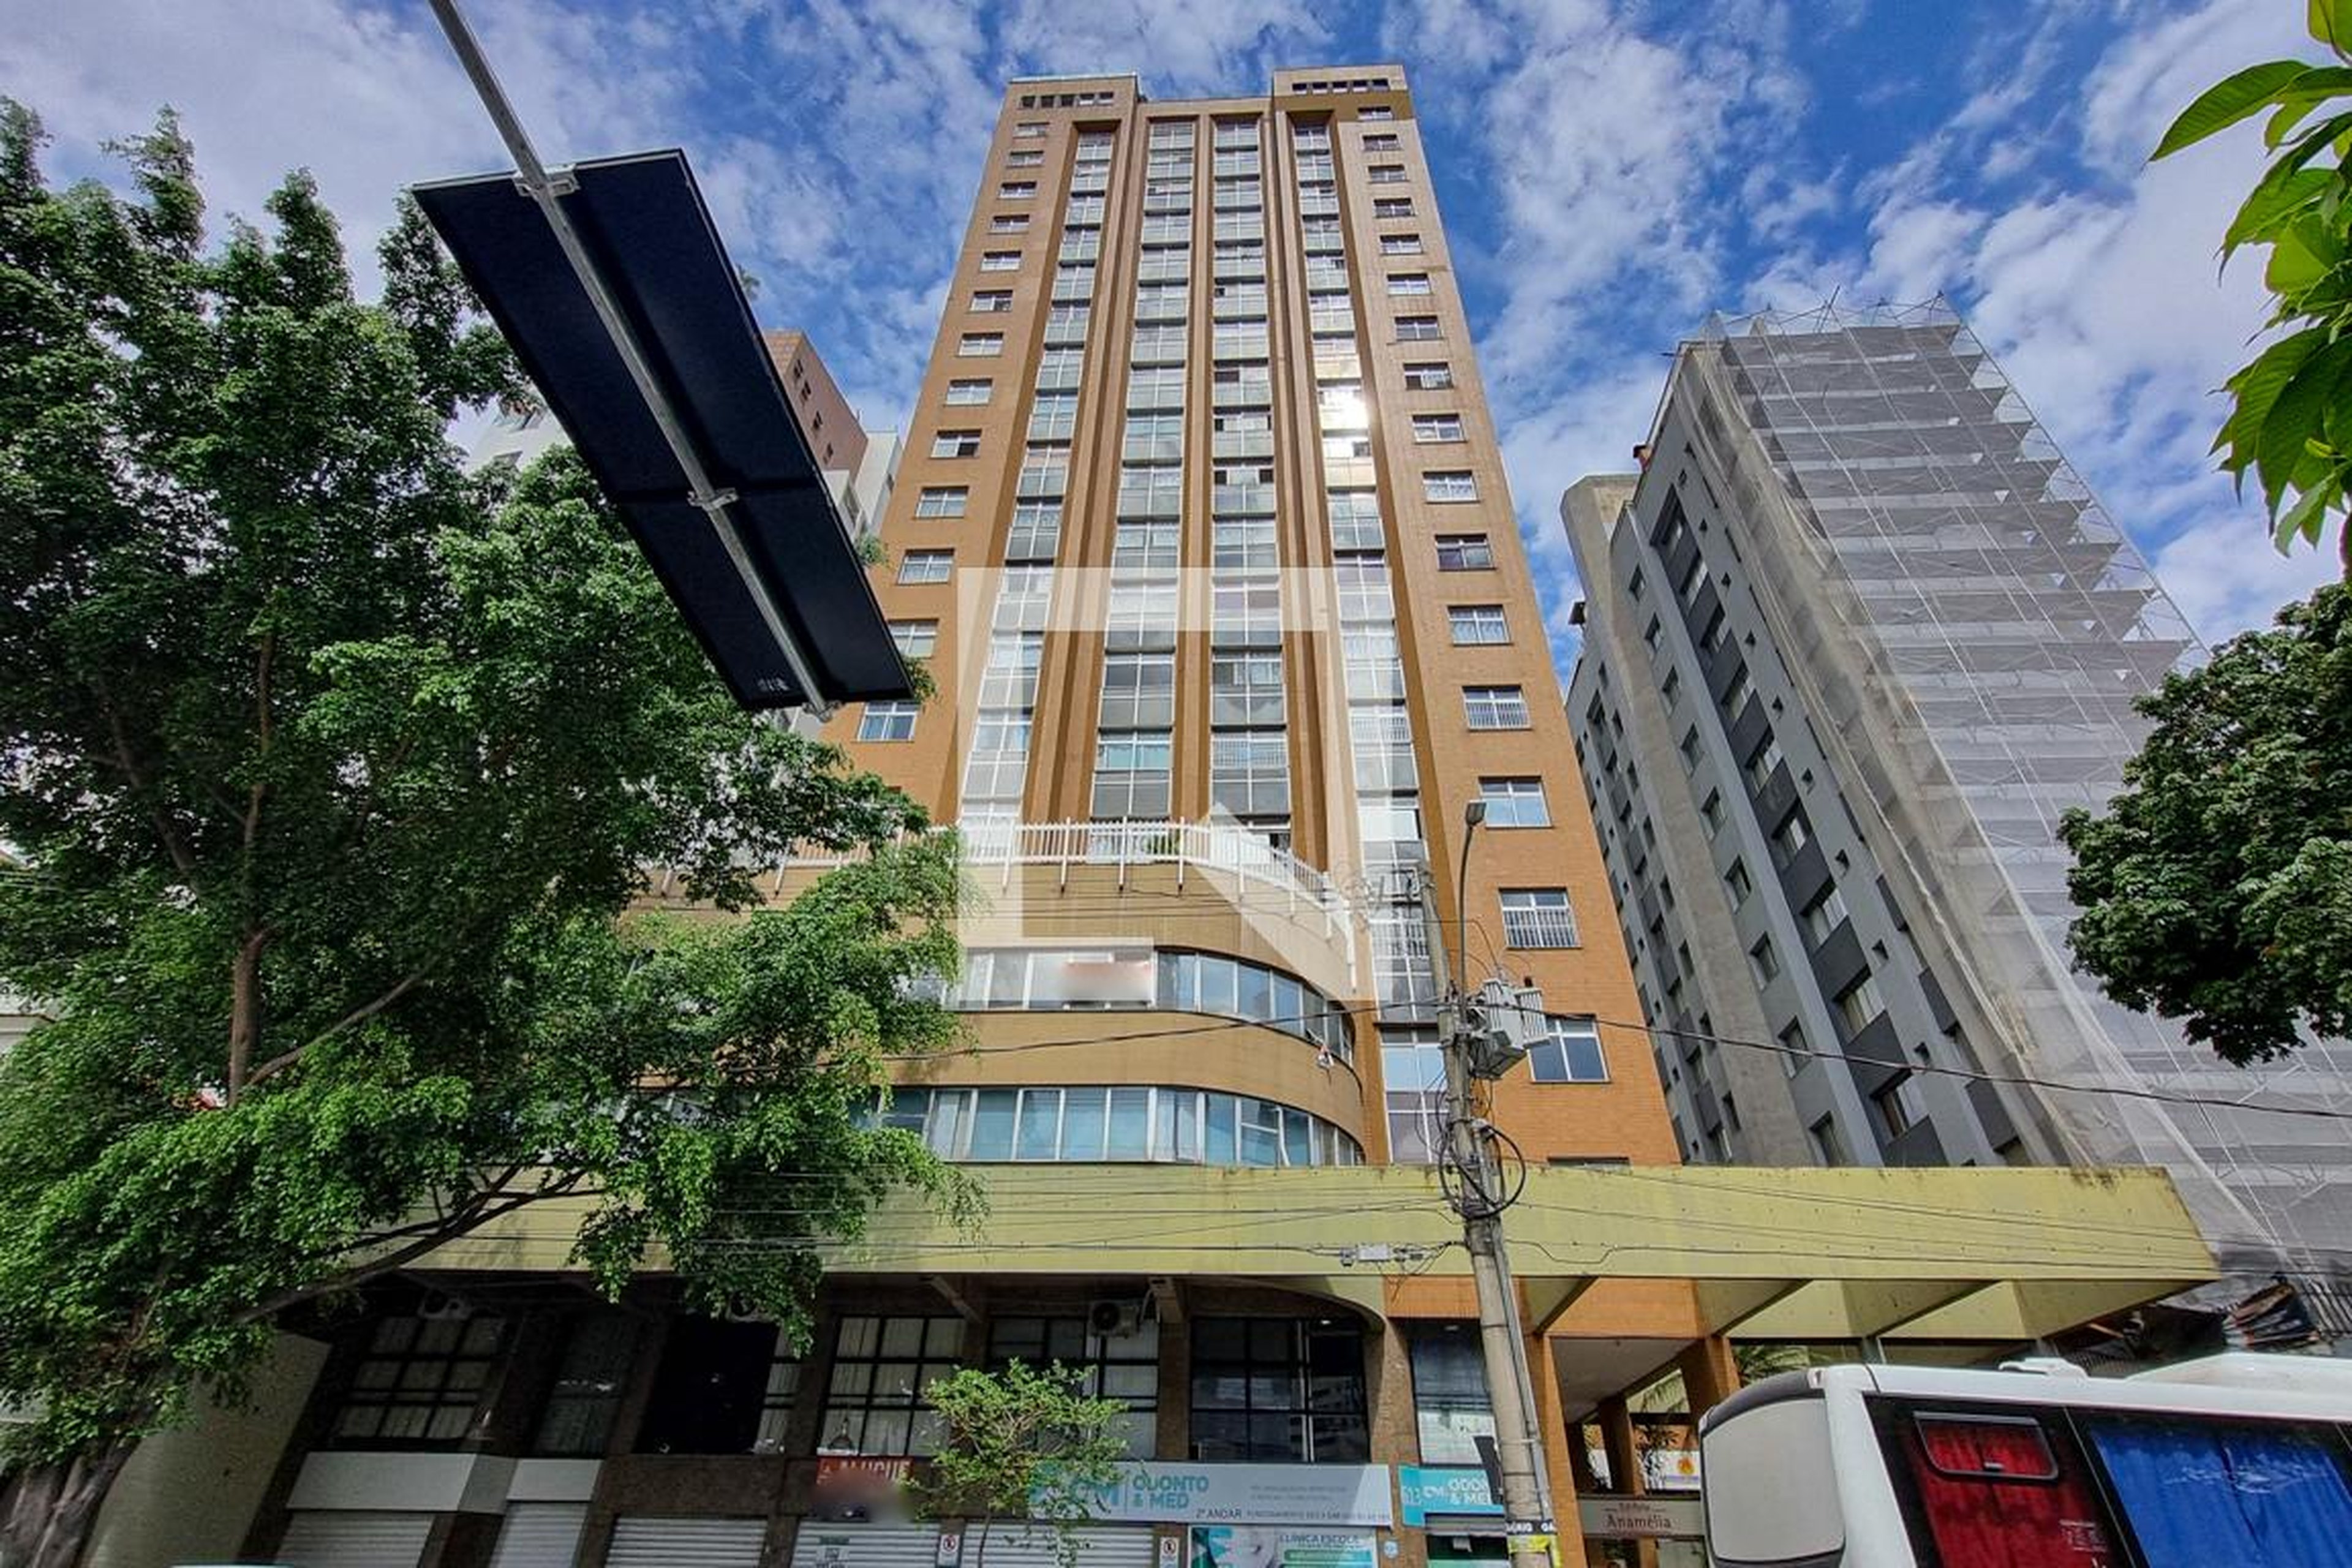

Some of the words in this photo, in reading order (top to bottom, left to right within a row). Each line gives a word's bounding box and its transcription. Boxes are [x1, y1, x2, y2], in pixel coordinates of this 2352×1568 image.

[1150, 1493, 1189, 1509] MED
[1464, 1493, 1491, 1505] ME
[1207, 1508, 1242, 1518] ANDAR
[1606, 1513, 1672, 1529] Anamélia
